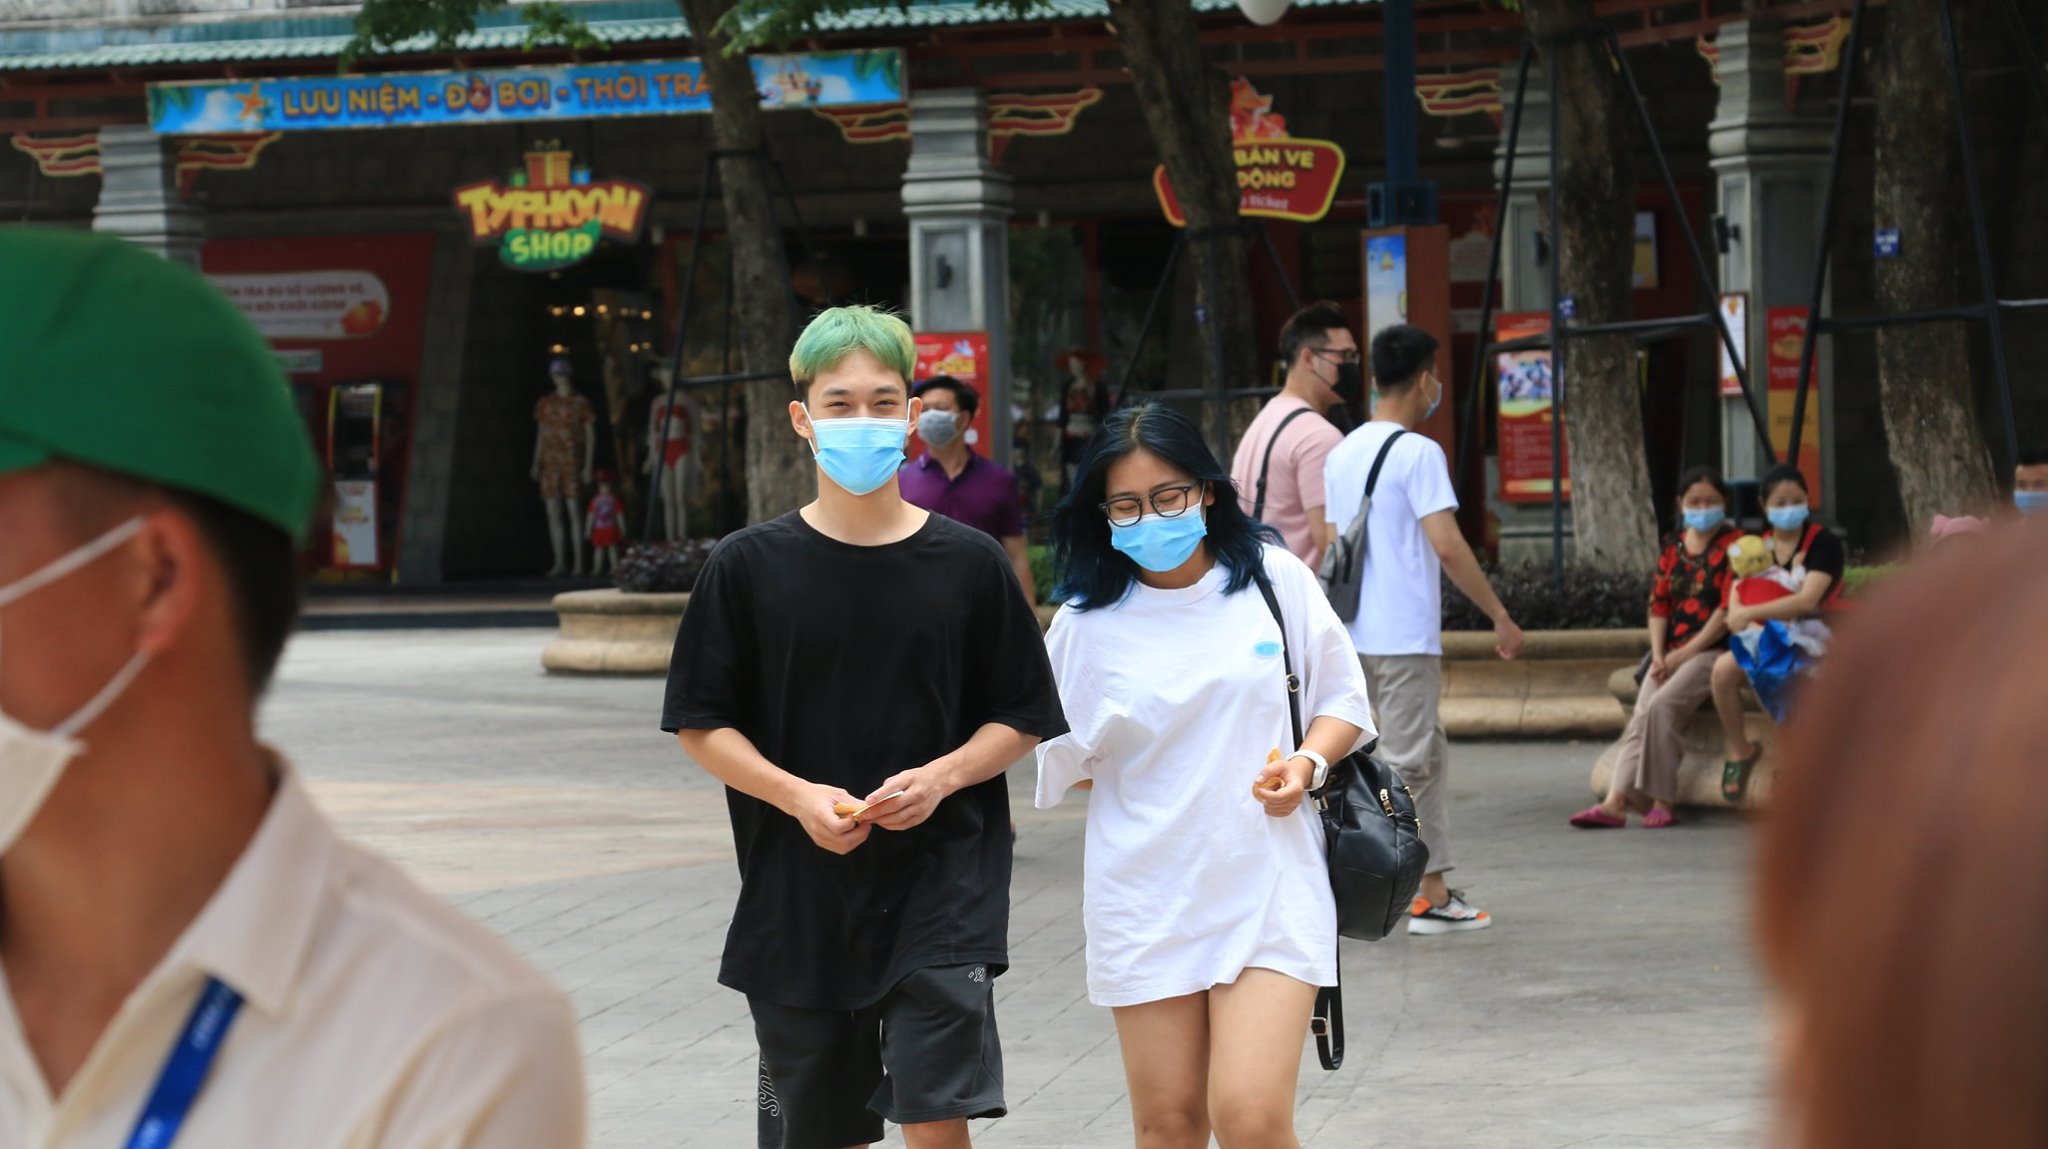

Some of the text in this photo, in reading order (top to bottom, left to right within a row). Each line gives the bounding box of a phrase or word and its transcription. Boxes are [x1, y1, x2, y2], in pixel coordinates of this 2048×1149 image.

[349, 81, 421, 115] NIỆM
[457, 184, 642, 235] TYPHOON
[510, 232, 593, 264] SHOP
